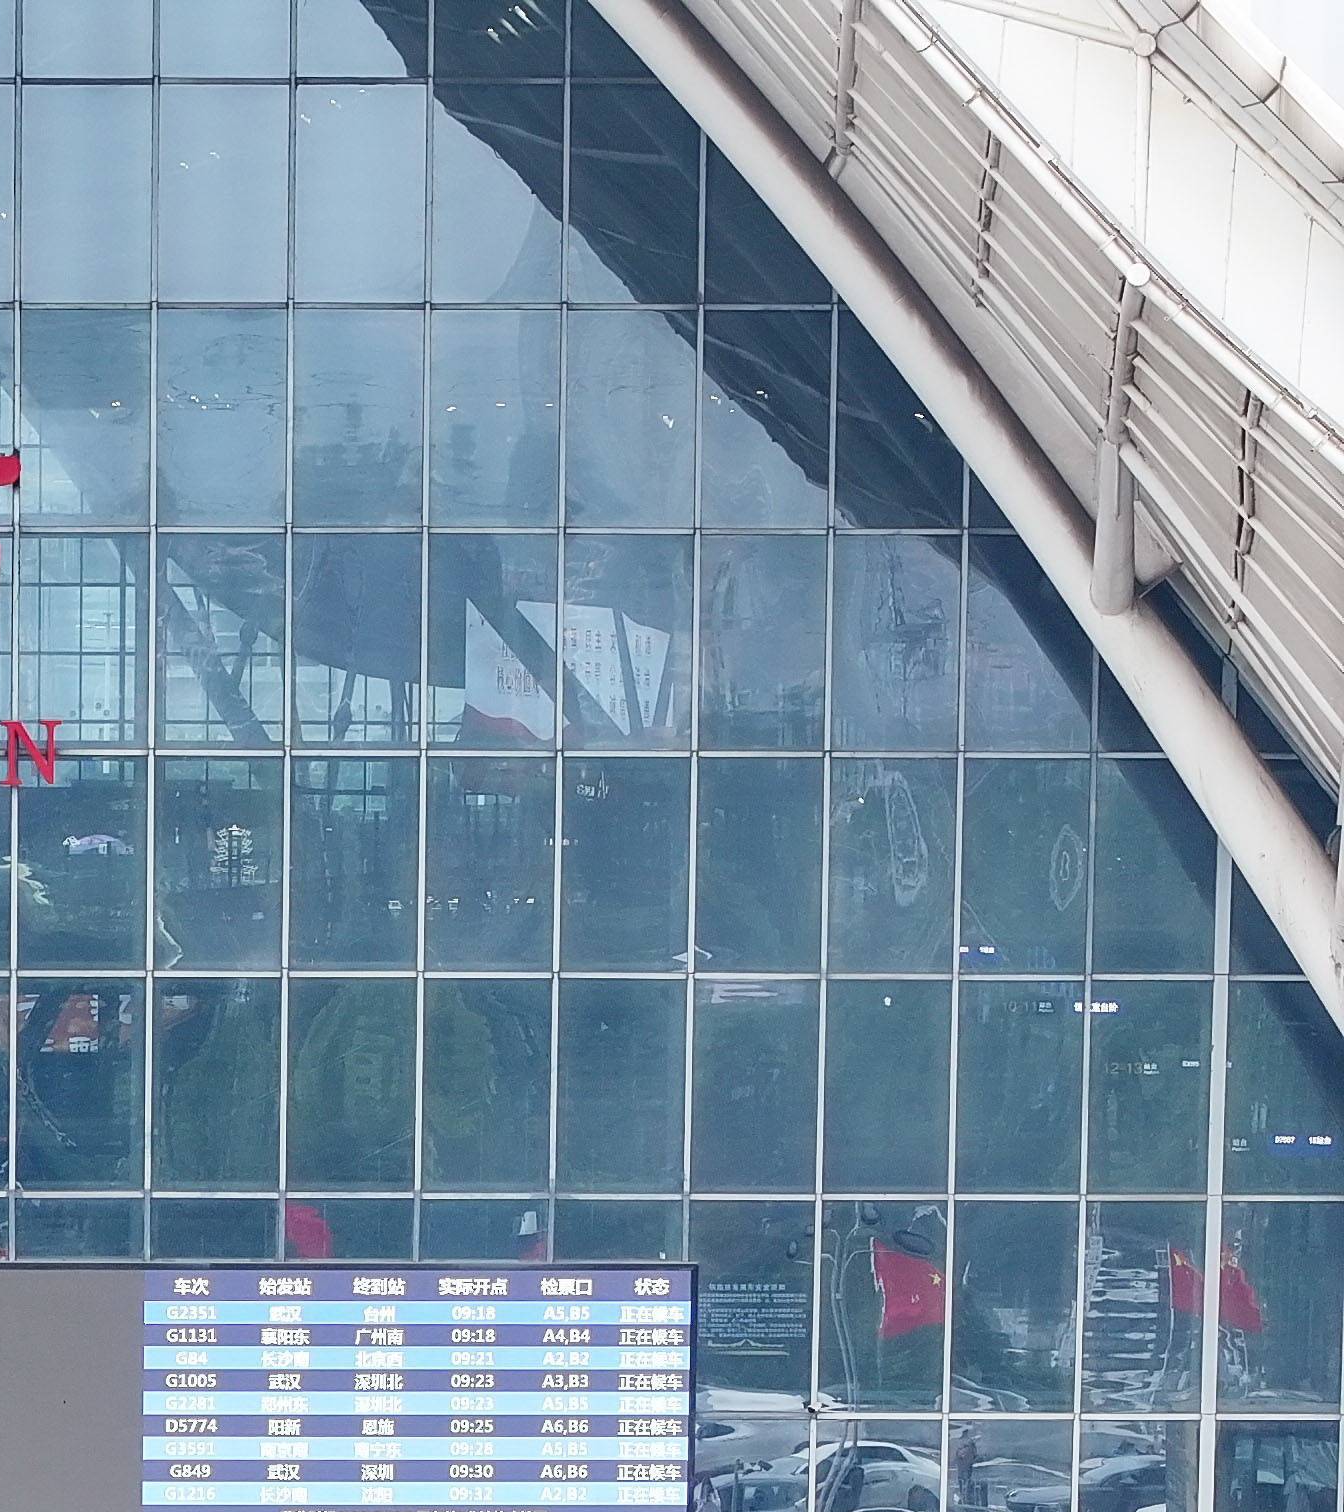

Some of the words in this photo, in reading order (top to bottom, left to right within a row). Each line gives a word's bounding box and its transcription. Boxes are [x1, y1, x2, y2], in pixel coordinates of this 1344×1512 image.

[173, 1277, 210, 1296] 车次
[258, 1277, 313, 1296] 始发站
[352, 1276, 407, 1296] 终到站
[438, 1277, 509, 1296] 实际开点
[540, 1277, 593, 1296] 检票口
[633, 1277, 670, 1296] 状态
[166, 1327, 218, 1343] G1131
[354, 1327, 404, 1346] 广州南
[451, 1328, 496, 1343] 09:18
[542, 1328, 591, 1345] A4,B4
[165, 1373, 217, 1388] G1005
[268, 1373, 301, 1391] 武汉
[354, 1373, 404, 1391] 深圳北
[450, 1373, 495, 1388] 09:23
[541, 1374, 589, 1391] A3,B3
[165, 1418, 218, 1433] D5774
[268, 1418, 301, 1436] 阳新
[361, 1418, 395, 1436] 恩施
[450, 1419, 494, 1434] 09:25
[541, 1419, 589, 1436] A6,B6
[169, 1464, 211, 1478] G849
[266, 1463, 301, 1481] 武汉
[361, 1463, 394, 1481] 深圳
[449, 1464, 494, 1479] 09:30
[540, 1464, 588, 1481] A6,B6
